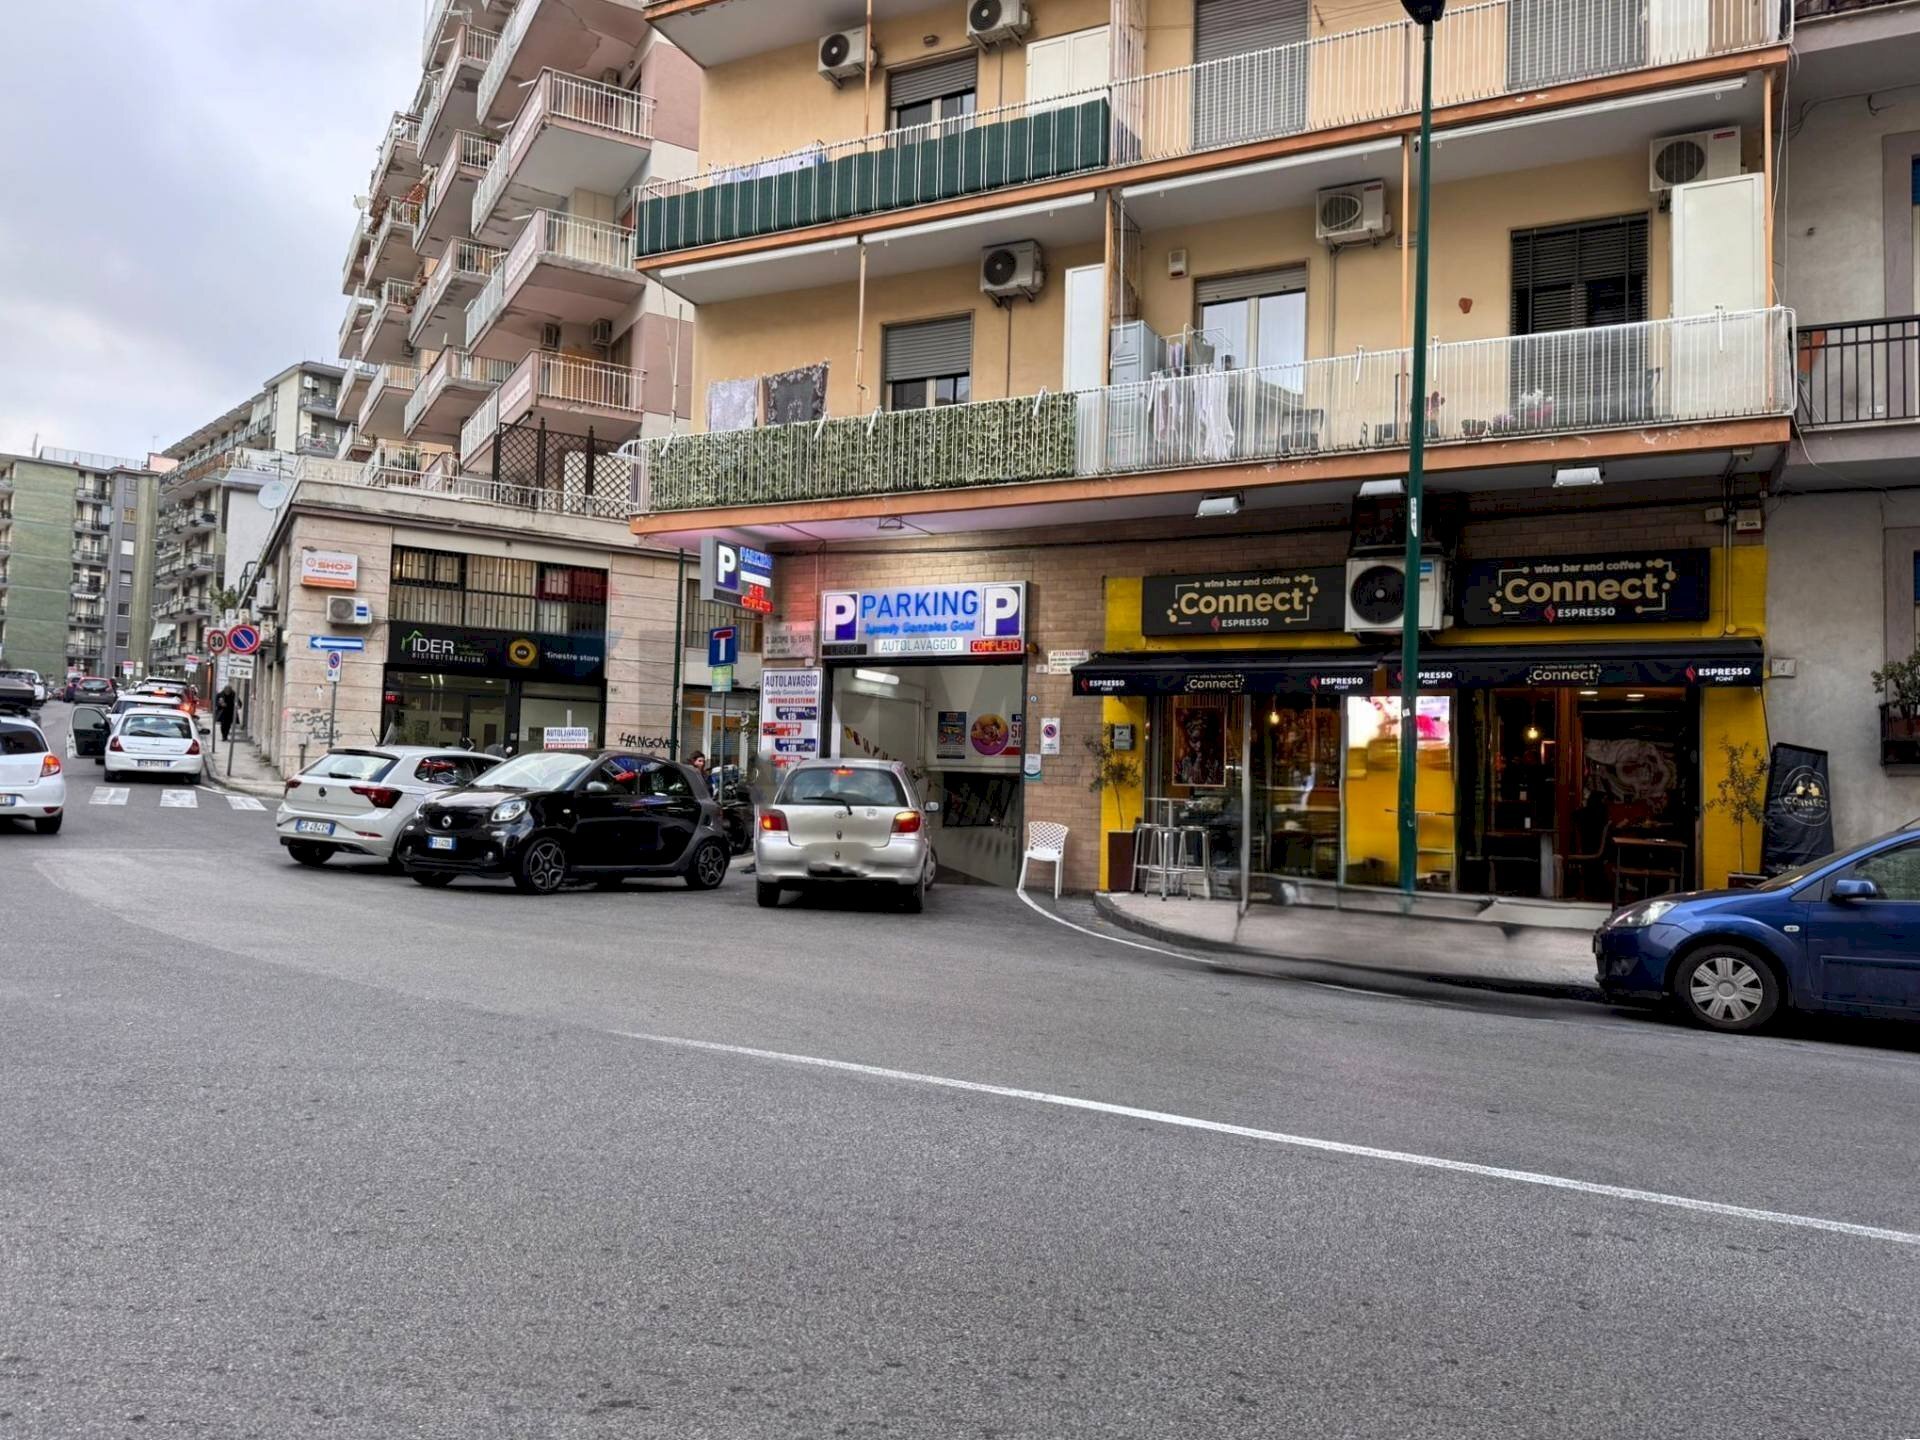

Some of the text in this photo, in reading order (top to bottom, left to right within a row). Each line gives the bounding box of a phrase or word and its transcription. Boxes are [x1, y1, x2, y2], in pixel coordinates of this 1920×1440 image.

[317, 561, 353, 571] SHOP
[717, 544, 737, 583] P
[1533, 560, 1642, 574] wine bar and coffee
[1204, 576, 1291, 588] wine bar and coffee
[1504, 573, 1658, 604] Connect
[1179, 587, 1304, 615] Connect
[825, 586, 1019, 641] P PARKING P
[1557, 607, 1616, 618] ESPRESSO
[950, 620, 976, 631] Gold
[1221, 618, 1270, 628] ESPRESSO
[211, 636, 223, 647] 30
[880, 638, 958, 652] AUTOLAVAGGIO
[971, 640, 1020, 653] COMPLETO
[547, 651, 600, 663] finestre store
[1418, 671, 1453, 679] PRESSO
[1532, 669, 1595, 681] Connect
[1698, 667, 1751, 677] ESPRESSO
[764, 675, 818, 688] AUTOLAVAGGIO
[1189, 679, 1240, 689] Connect
[1320, 677, 1364, 685] ESPRESSO
[546, 728, 587, 737] AUTOLAVAGGIO
